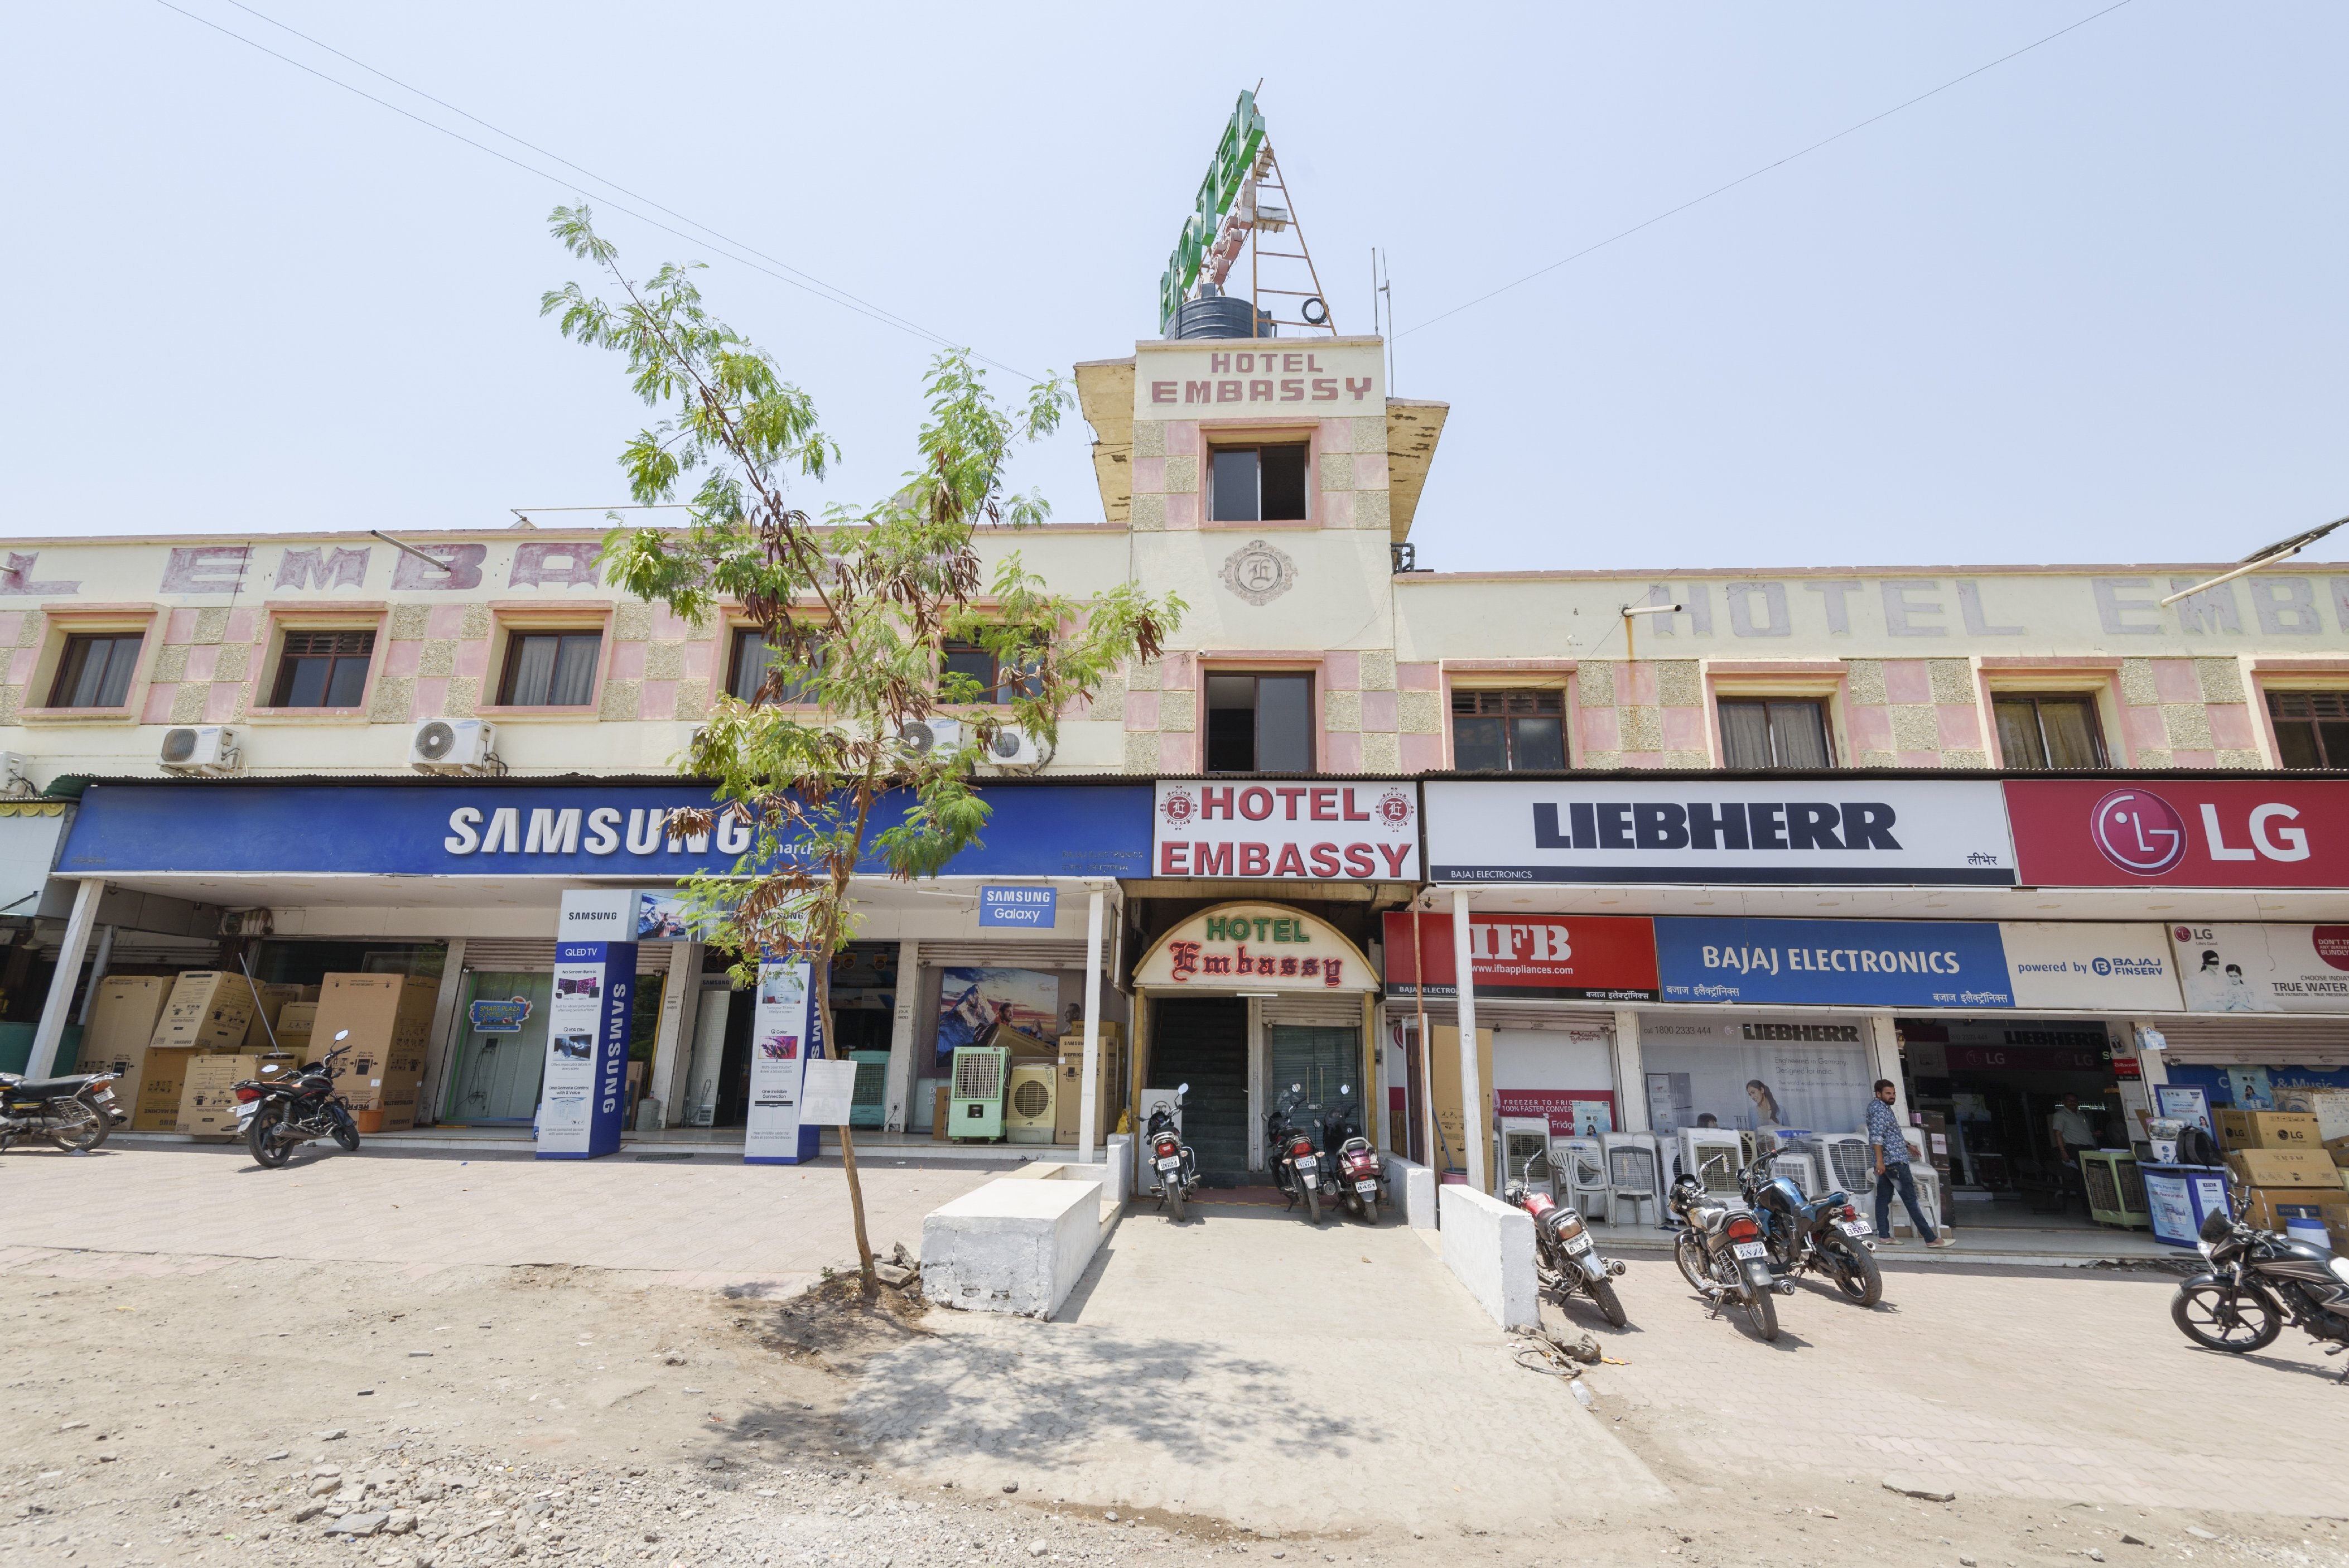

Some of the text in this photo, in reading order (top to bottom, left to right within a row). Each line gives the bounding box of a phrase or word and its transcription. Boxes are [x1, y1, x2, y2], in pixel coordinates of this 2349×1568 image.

[1211, 353, 1323, 374] HOTEL
[1151, 377, 1372, 404] EMBASSY
[1648, 581, 2025, 637] HOTEL
[1201, 786, 1370, 821] HOTEL
[1533, 802, 1904, 850] LIEBHERR
[2199, 803, 2311, 862] LG
[1161, 841, 1413, 879] EMBASSY
[1966, 852, 1997, 865] लीभेर
[1451, 870, 1474, 879] BAJAJ
[986, 890, 1050, 903] SAMSUNG
[995, 908, 1040, 923] Galaxy
[1207, 918, 1310, 943] HOTEL
[2193, 929, 2213, 940] LG
[1469, 923, 1571, 961] IFB
[565, 948, 597, 956] QLED TV
[1169, 942, 1342, 988] Embassy
[1702, 945, 1960, 976] BAJAJ ELECTRONICS
[2112, 958, 2162, 967] BAJAJ
[1471, 963, 1573, 975] www.ifbappliances.com
[2018, 961, 2087, 975] powered by
[2114, 967, 2163, 976] FINSERV
[1666, 986, 1689, 995] बजाज
[2271, 982, 2348, 992] TRUE WATER
[1932, 993, 1956, 1002] बजाज
[1655, 1026, 1674, 1035] 1800
[1697, 1026, 1711, 1035] 444
[1742, 1023, 1860, 1042] LIEBHERR
[2004, 1030, 2104, 1047] LIEBHERR
[603, 983, 626, 1113] SAMSUNG
[1774, 1056, 1809, 1066] Engineered
[1986, 1053, 2005, 1065] LG
[2074, 1054, 2093, 1067] LG
[1776, 1066, 1805, 1076] Designed
[2290, 1131, 2303, 1139] LG
[1161, 1160, 1177, 1169] 2624
[1298, 1160, 1314, 1168] 8570
[1846, 1226, 1870, 1235] 3690
